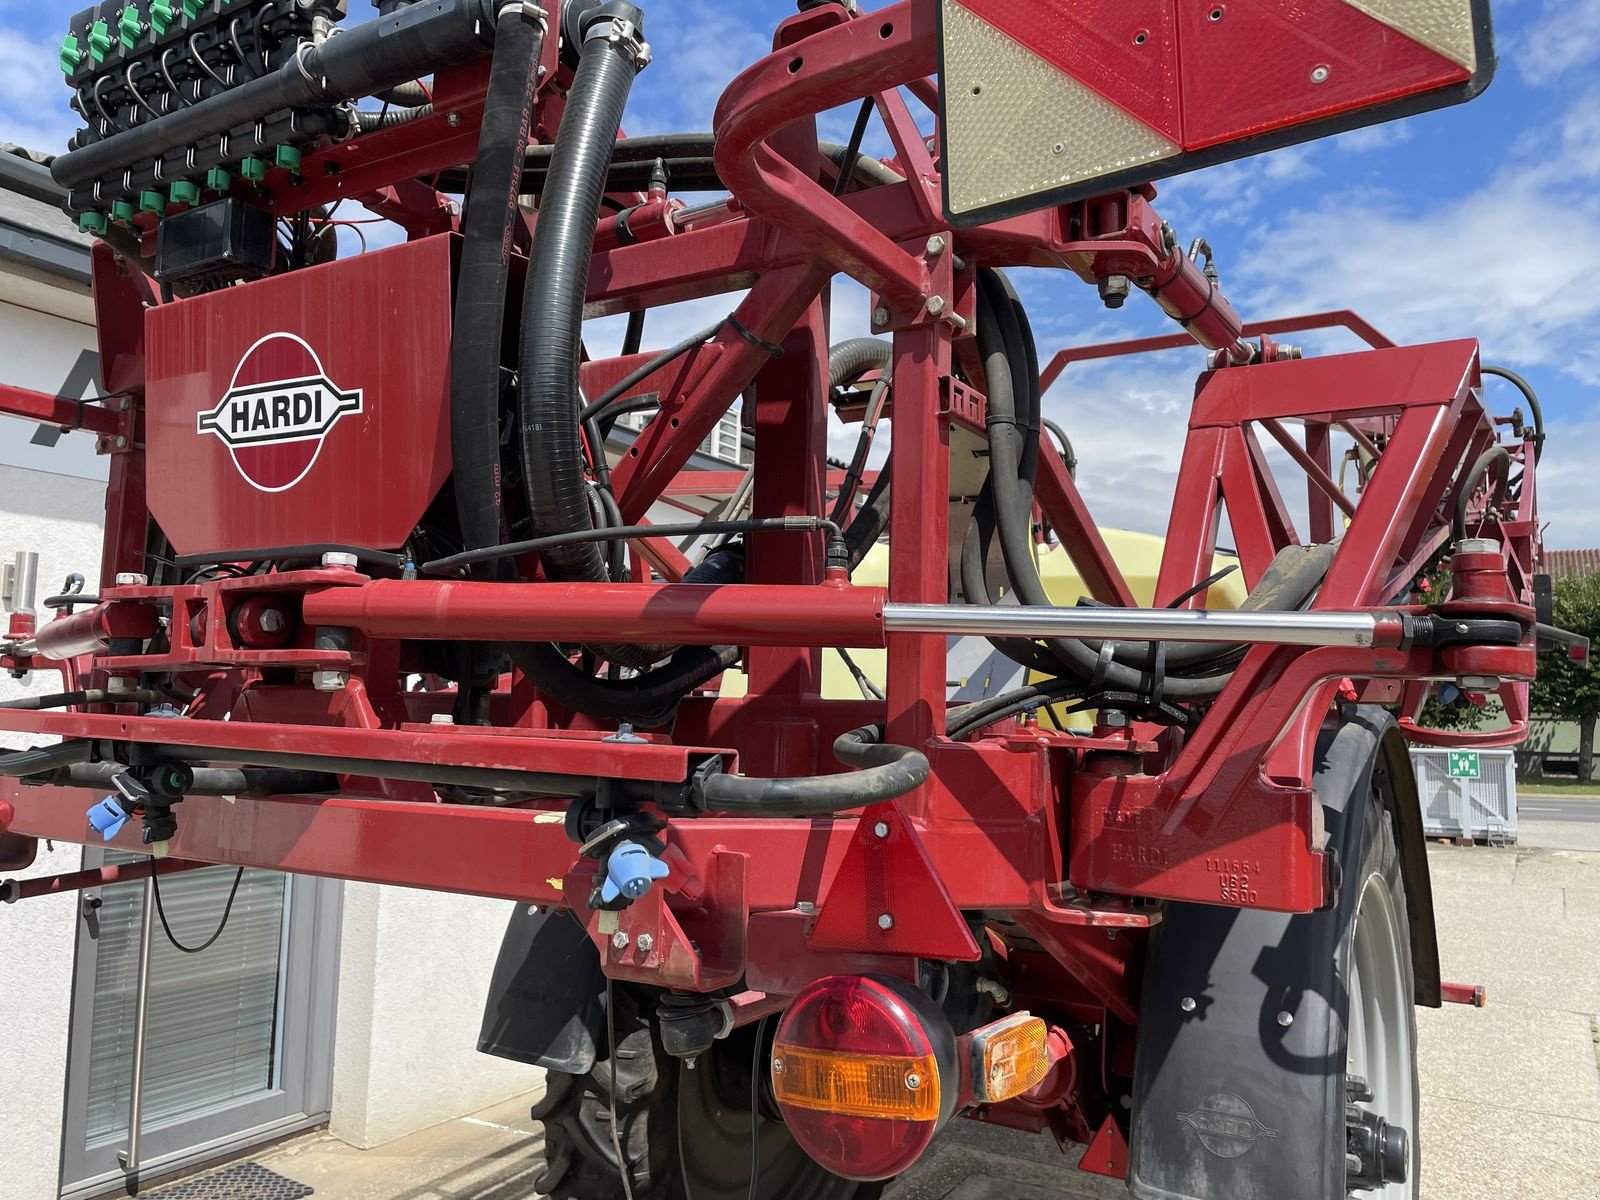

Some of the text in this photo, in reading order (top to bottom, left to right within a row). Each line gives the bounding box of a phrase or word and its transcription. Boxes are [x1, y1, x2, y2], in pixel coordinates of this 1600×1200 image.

[520, 108, 529, 137] BAR
[231, 390, 322, 433] HARDI
[1111, 843, 1169, 866] HARDI
